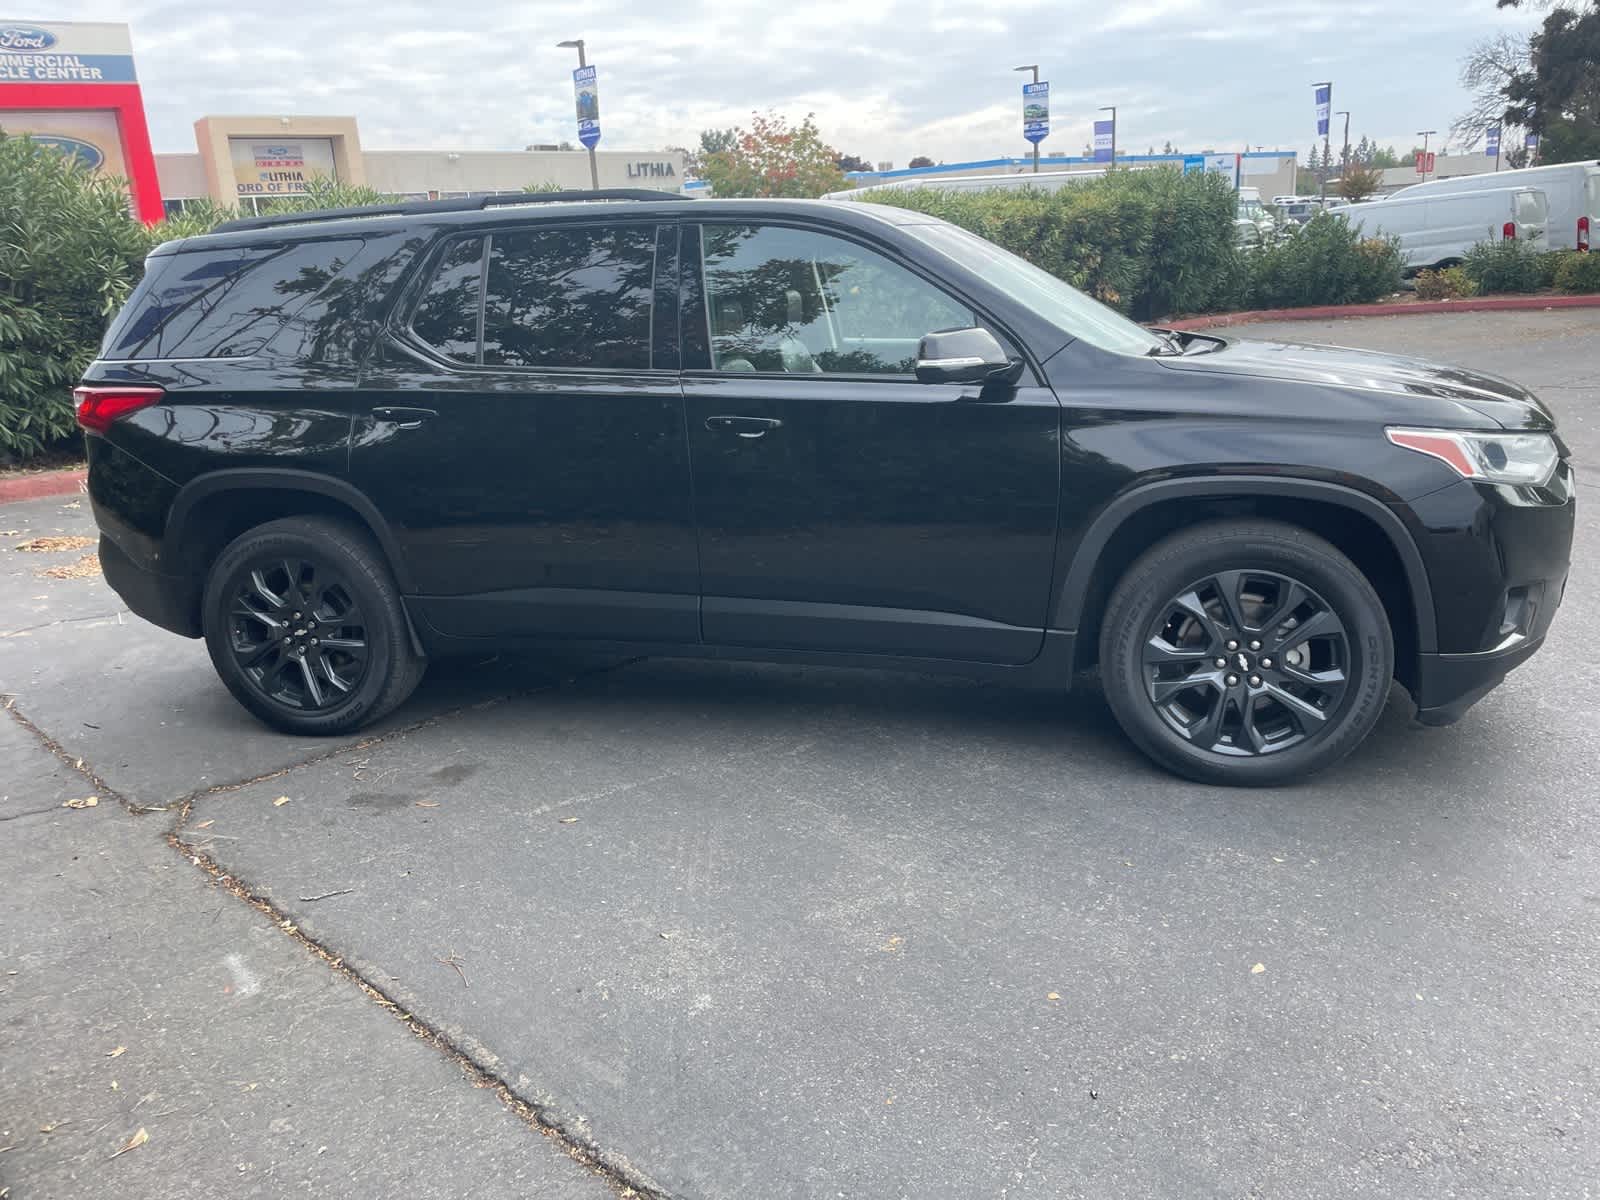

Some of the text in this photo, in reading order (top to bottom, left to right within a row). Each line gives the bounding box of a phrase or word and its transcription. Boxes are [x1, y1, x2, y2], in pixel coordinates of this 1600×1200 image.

[0, 29, 45, 48] Ford
[34, 67, 103, 79] CENTER
[628, 162, 675, 177] LITHIA
[268, 171, 304, 182] LITHIA
[237, 183, 263, 192] ORD
[268, 183, 283, 191] OF
